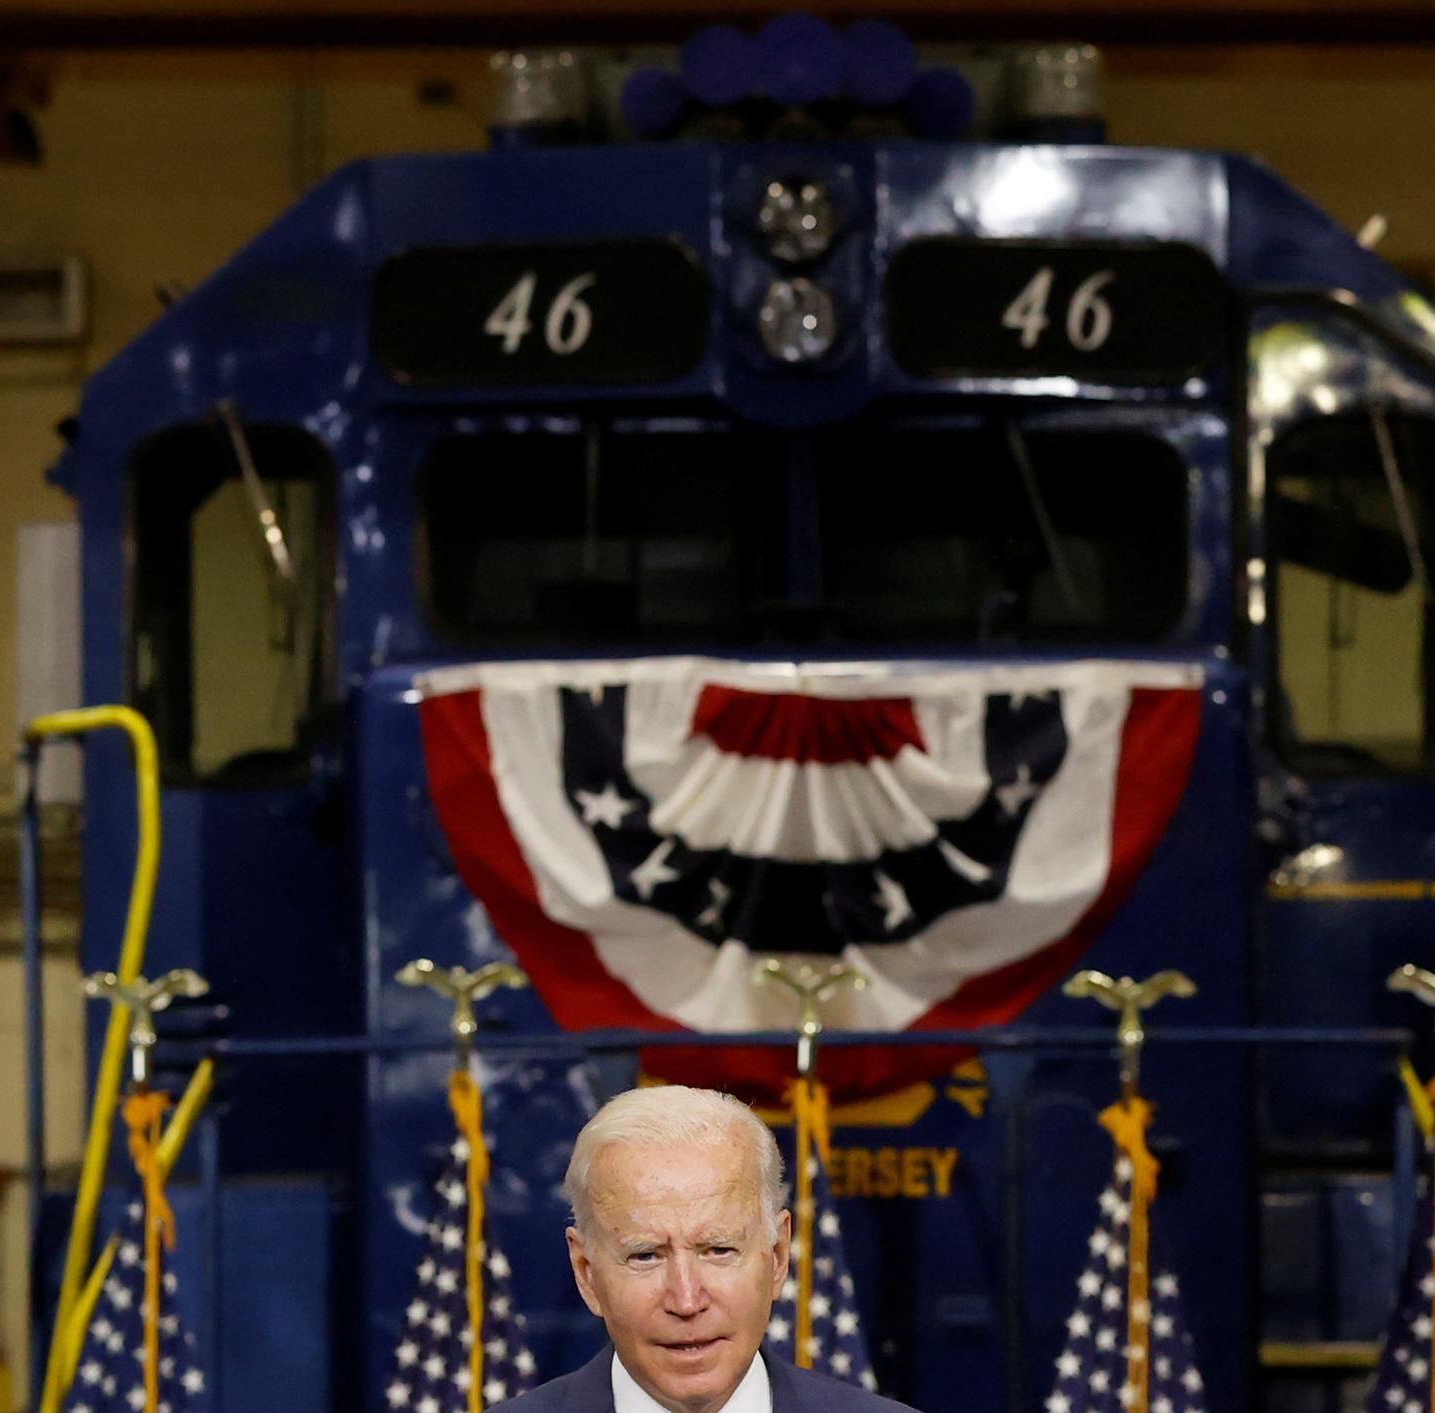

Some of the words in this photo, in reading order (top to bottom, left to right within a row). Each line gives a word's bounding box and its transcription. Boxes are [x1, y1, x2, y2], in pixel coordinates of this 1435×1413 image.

[484, 271, 596, 354] 46
[1003, 267, 1114, 350] 46
[829, 1145, 958, 1200] ERSEY
